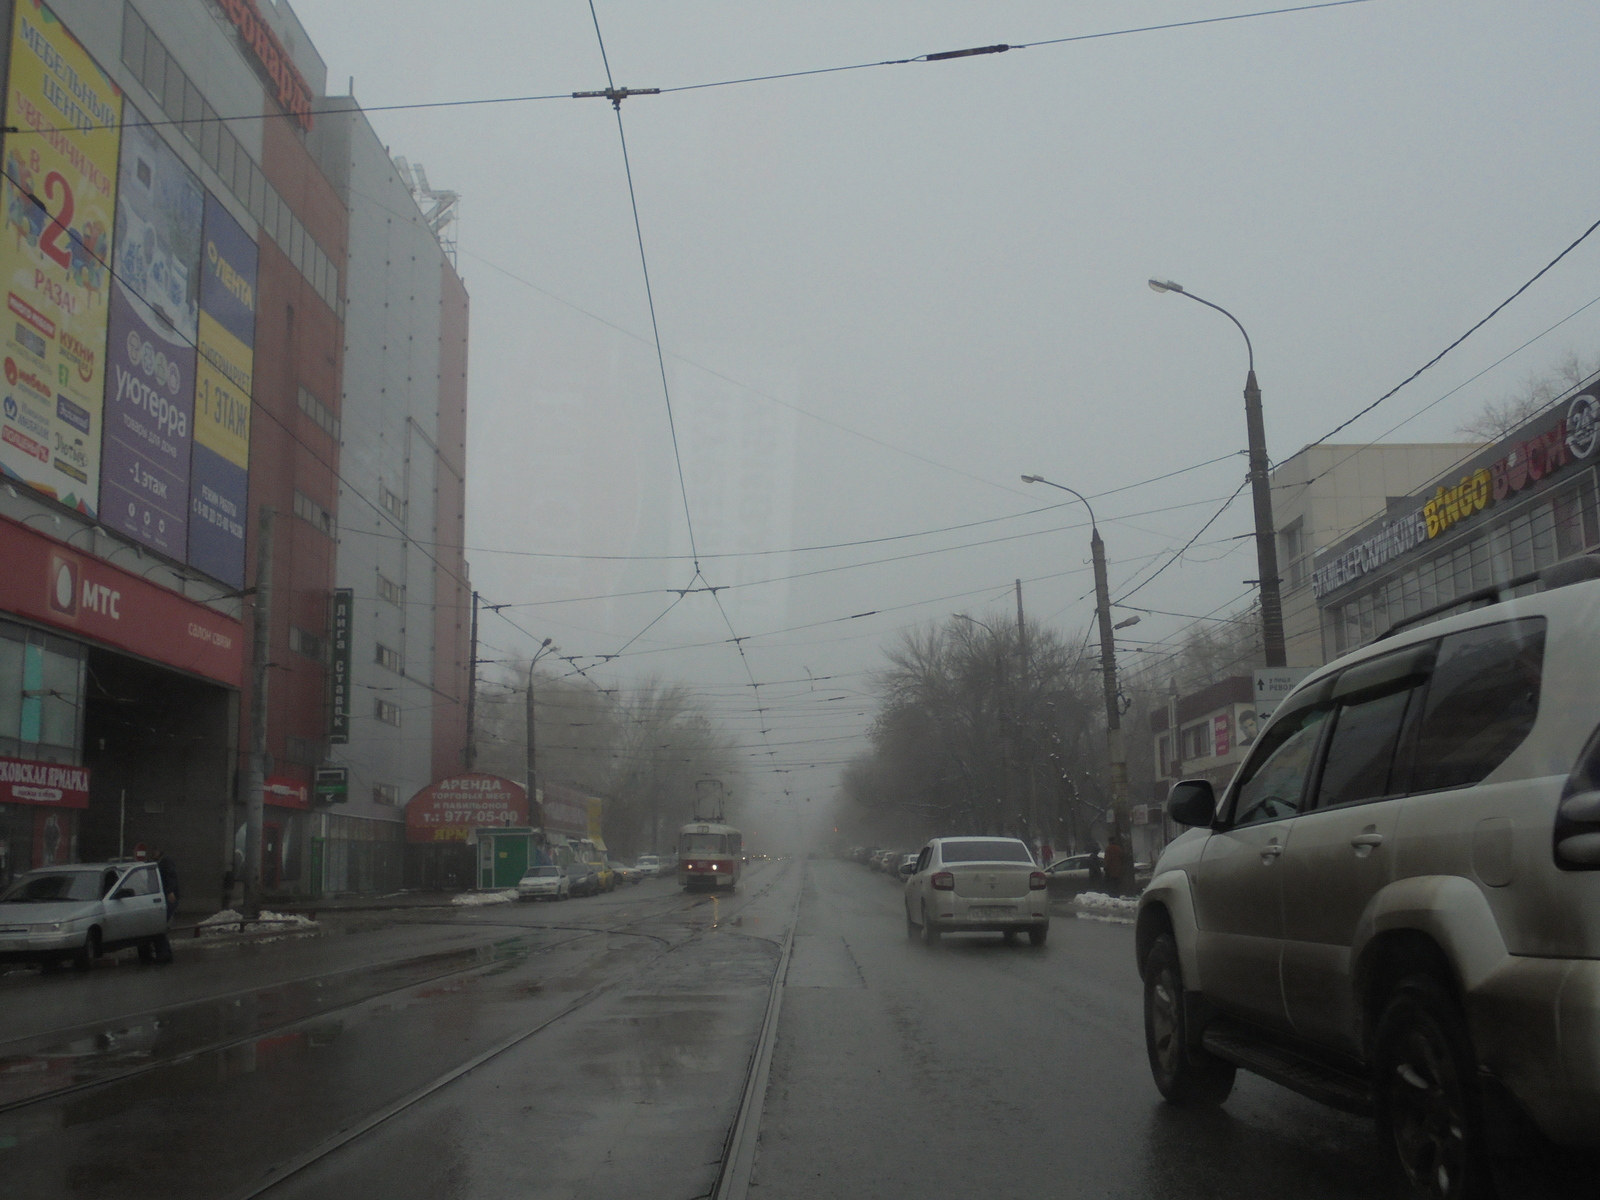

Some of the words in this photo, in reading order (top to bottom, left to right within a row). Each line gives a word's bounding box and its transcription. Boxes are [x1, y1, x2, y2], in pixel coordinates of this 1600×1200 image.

[19, 16, 115, 134] МЕБЕЛЬНЫЙ
[221, 0, 313, 132] еонардо
[42, 73, 93, 136] ЦЕНТР
[15, 90, 110, 197] УВЕЛИЧИЛСЯ
[30, 149, 41, 173] В
[39, 171, 74, 269] 2
[34, 268, 76, 316] РАЗА!
[214, 258, 253, 312] ЛЕНТА
[115, 363, 187, 439] уютерра
[214, 385, 248, 440] ЭТАЖ
[129, 461, 139, 483] -1
[141, 470, 167, 499] этаж
[1393, 507, 1426, 555] КЛУБ
[82, 580, 121, 619] МТС
[187, 621, 211, 644] салон
[336, 604, 346, 649] Лига
[334, 660, 344, 727] Ставок
[0, 761, 47, 786] КОВСКАЯ
[47, 767, 88, 792] ЯРМАРКА
[432, 792, 483, 800] ТОРГОВЫХ
[441, 779, 502, 791] АРЕНДА
[434, 828, 468, 841] ЯРМ
[444, 811, 518, 822] 977-05-00
